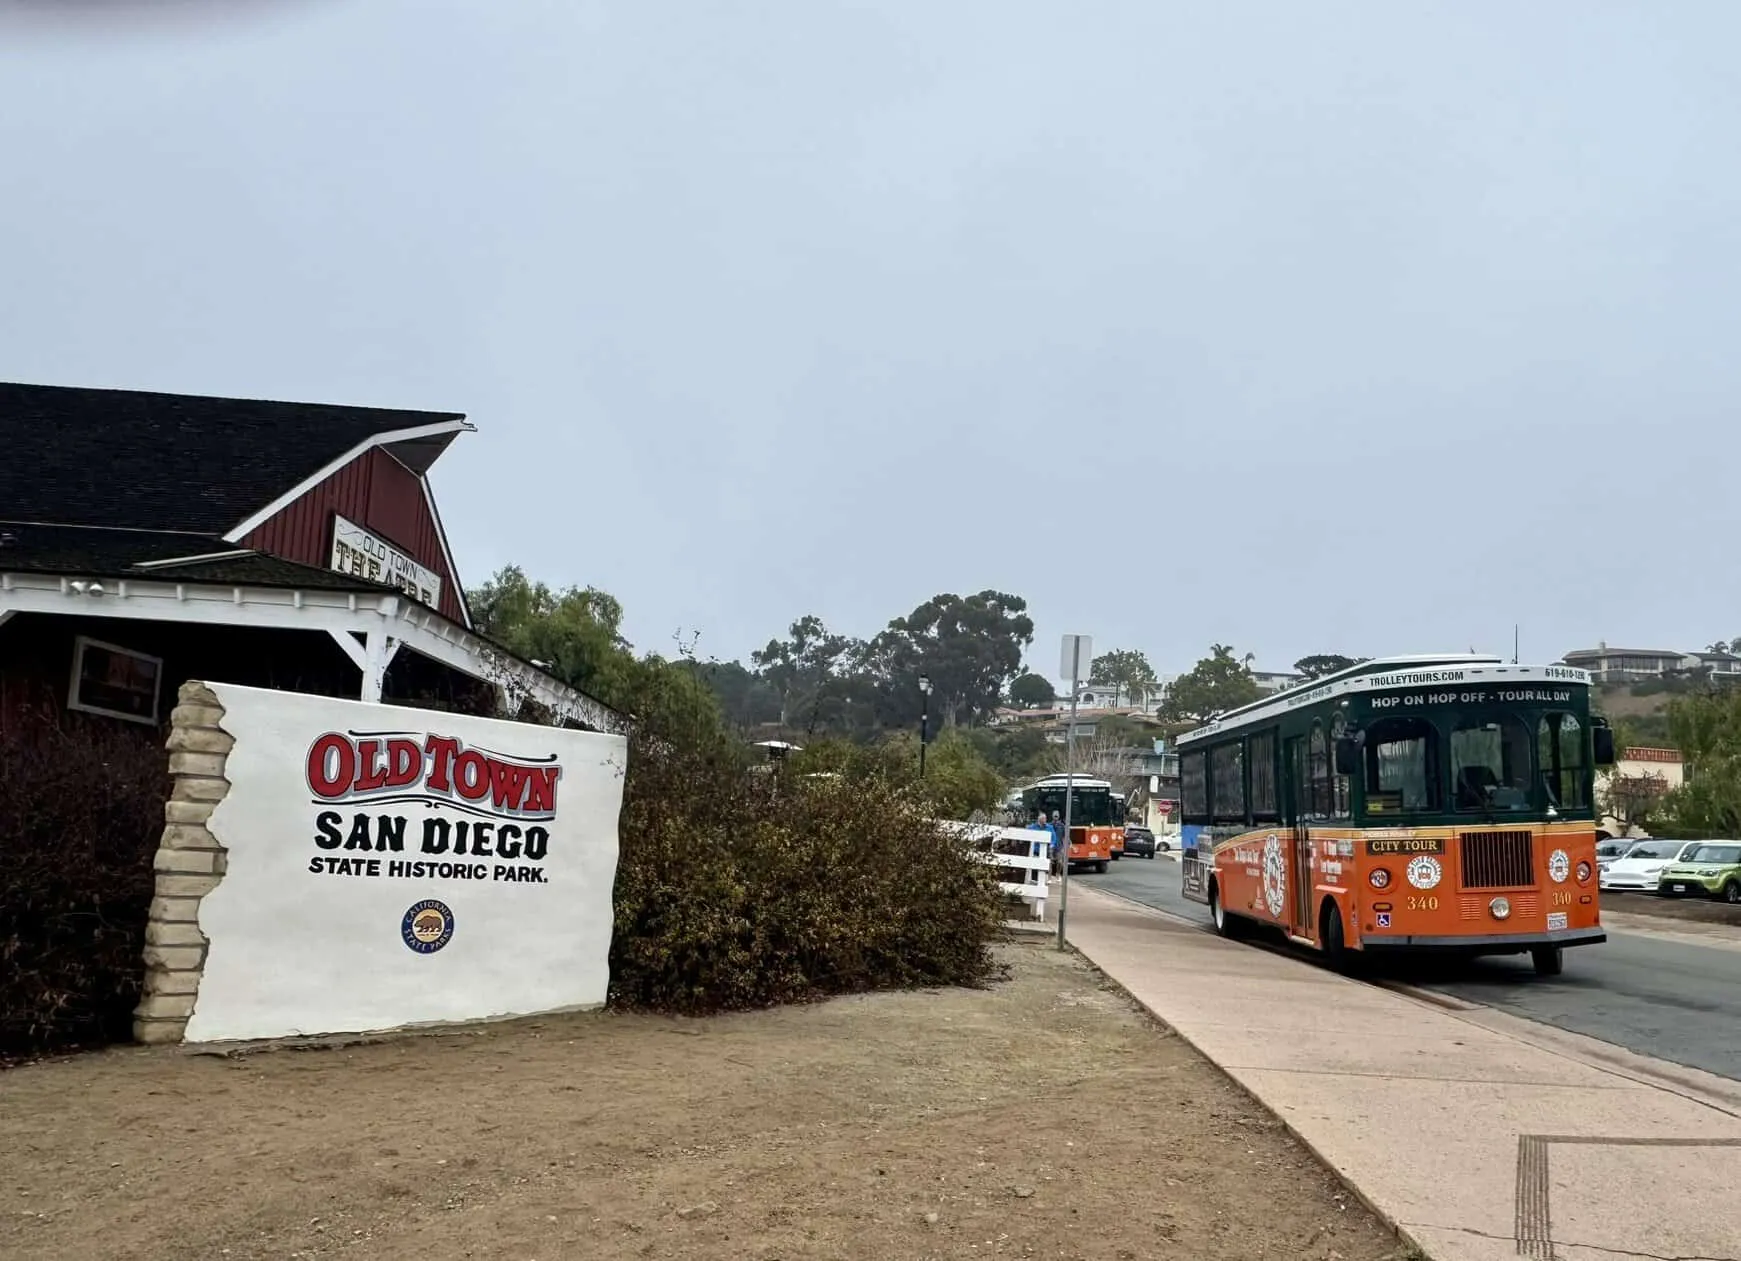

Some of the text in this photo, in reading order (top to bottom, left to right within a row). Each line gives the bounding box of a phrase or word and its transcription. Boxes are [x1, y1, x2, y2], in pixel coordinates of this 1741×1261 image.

[363, 535, 418, 580] OLD TOWN
[1369, 671, 1464, 687] TROLLEYTOURS.COM
[1371, 696, 1400, 709] HOP
[1404, 695, 1424, 706] ON
[1428, 692, 1457, 704] HOP
[1461, 691, 1486, 703] OFF
[1497, 690, 1534, 701] TOUR
[1536, 690, 1552, 701] ALL
[1553, 691, 1570, 701] DAY
[306, 732, 562, 815] OLD TOWN
[314, 811, 550, 860] SAN DIEGO
[1372, 839, 1438, 852] CITY TOUR
[308, 856, 381, 877] STATE
[388, 860, 488, 881] HISTORIC
[1407, 896, 1438, 911] 340
[1552, 891, 1572, 906] 340
[405, 900, 453, 923] CALIFORNIA
